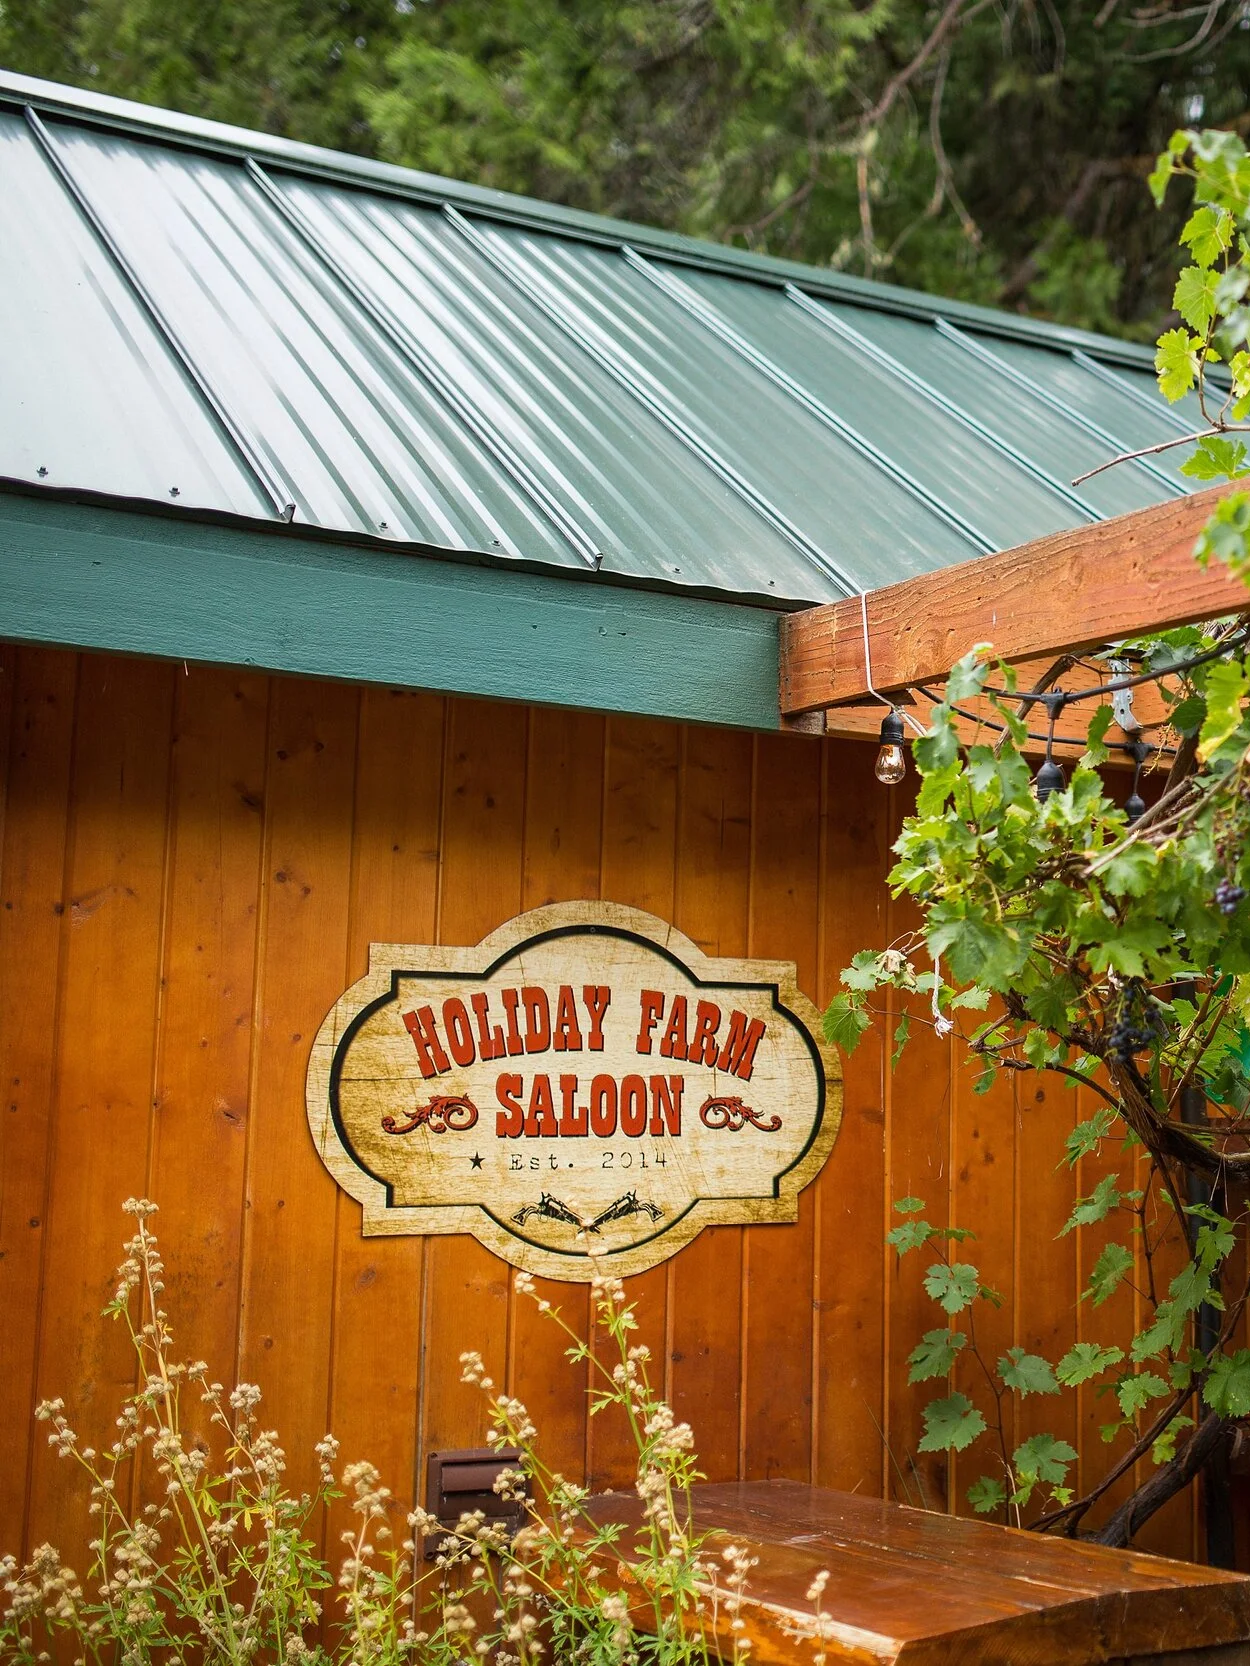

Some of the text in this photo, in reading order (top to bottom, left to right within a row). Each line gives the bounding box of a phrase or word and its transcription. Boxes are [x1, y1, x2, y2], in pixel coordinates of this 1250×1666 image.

[402, 985, 766, 1081] HOLIDAY FARM
[495, 1073, 685, 1138] SALOON
[508, 1151, 668, 1171] Est. 2014
